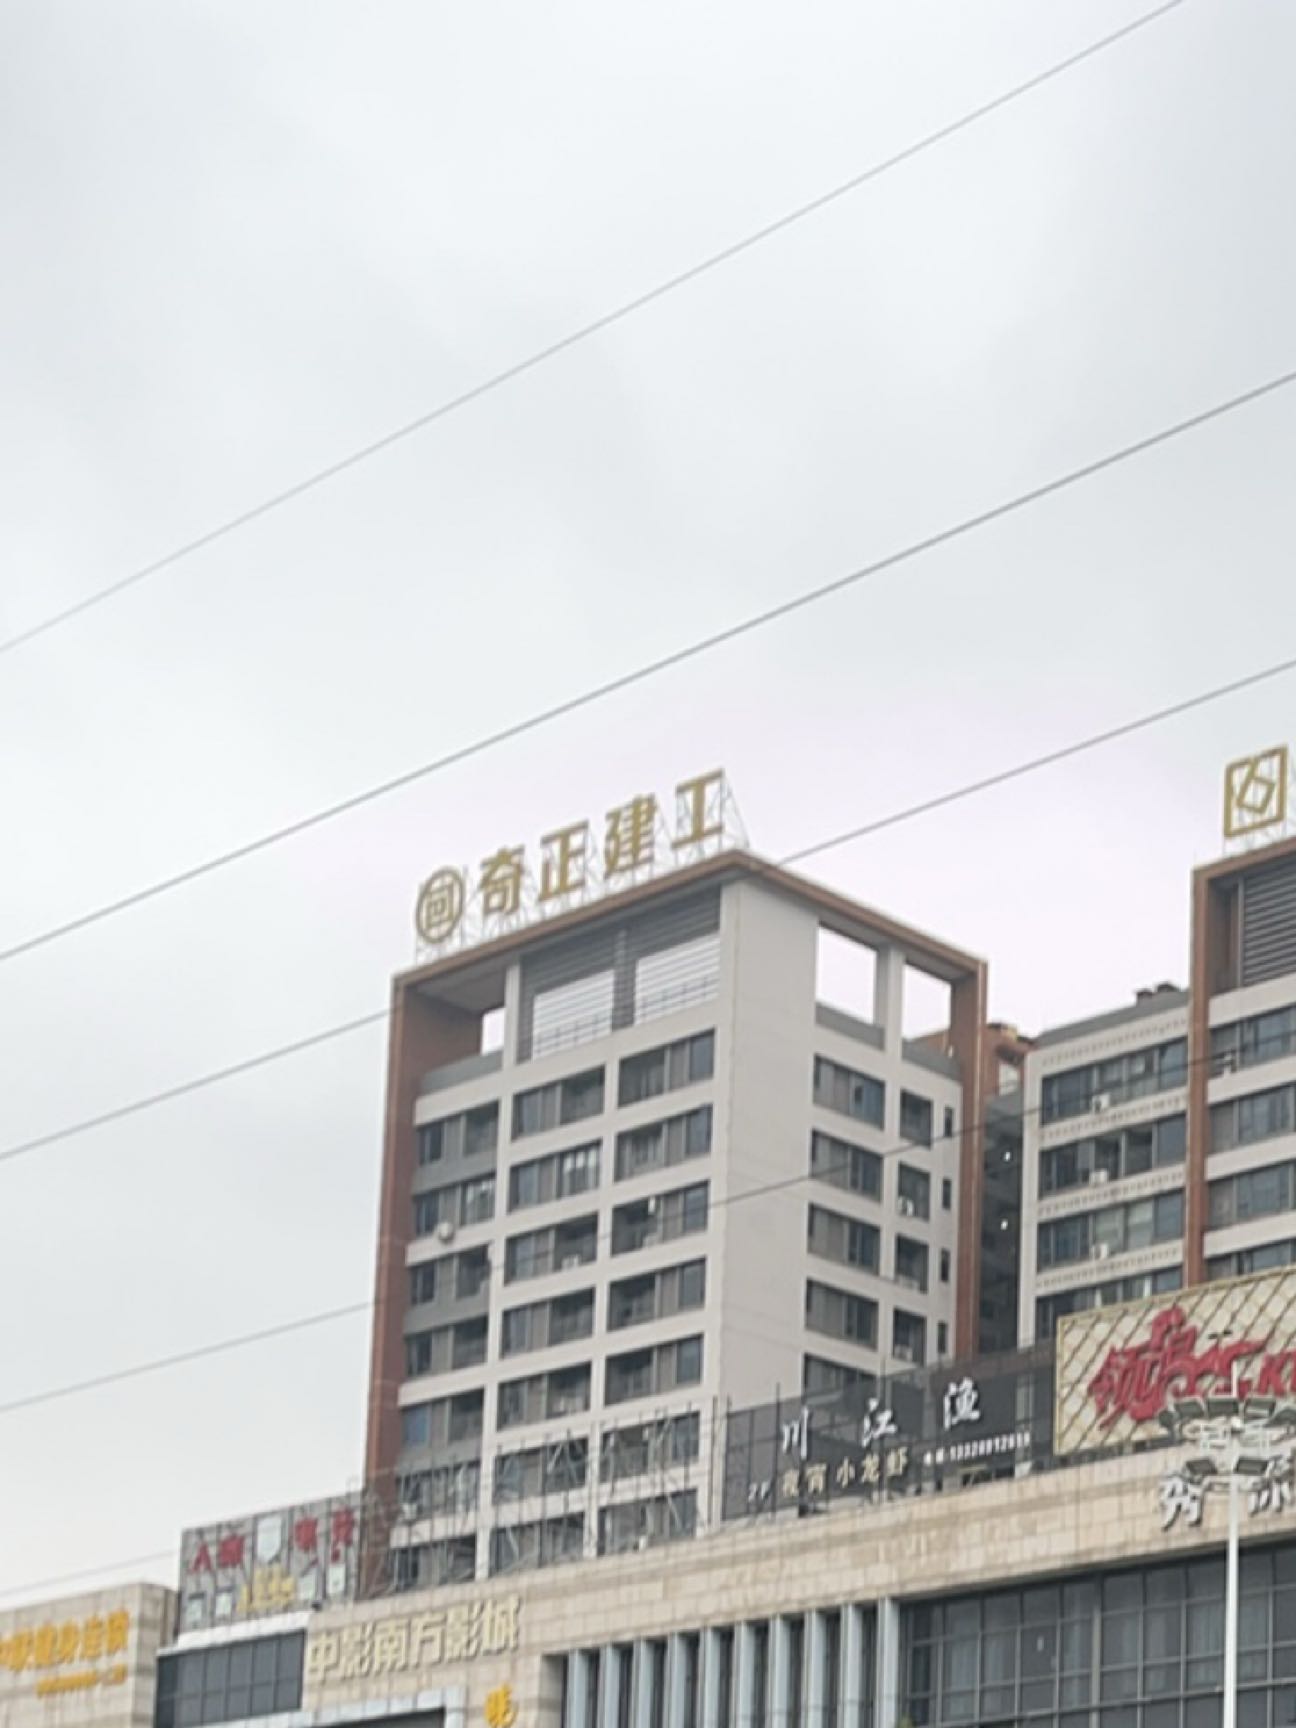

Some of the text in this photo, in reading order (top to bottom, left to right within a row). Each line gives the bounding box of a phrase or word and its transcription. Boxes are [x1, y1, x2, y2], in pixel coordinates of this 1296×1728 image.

[479, 767, 725, 917] 奇正建工
[308, 1595, 520, 1682] 中影南方影城
